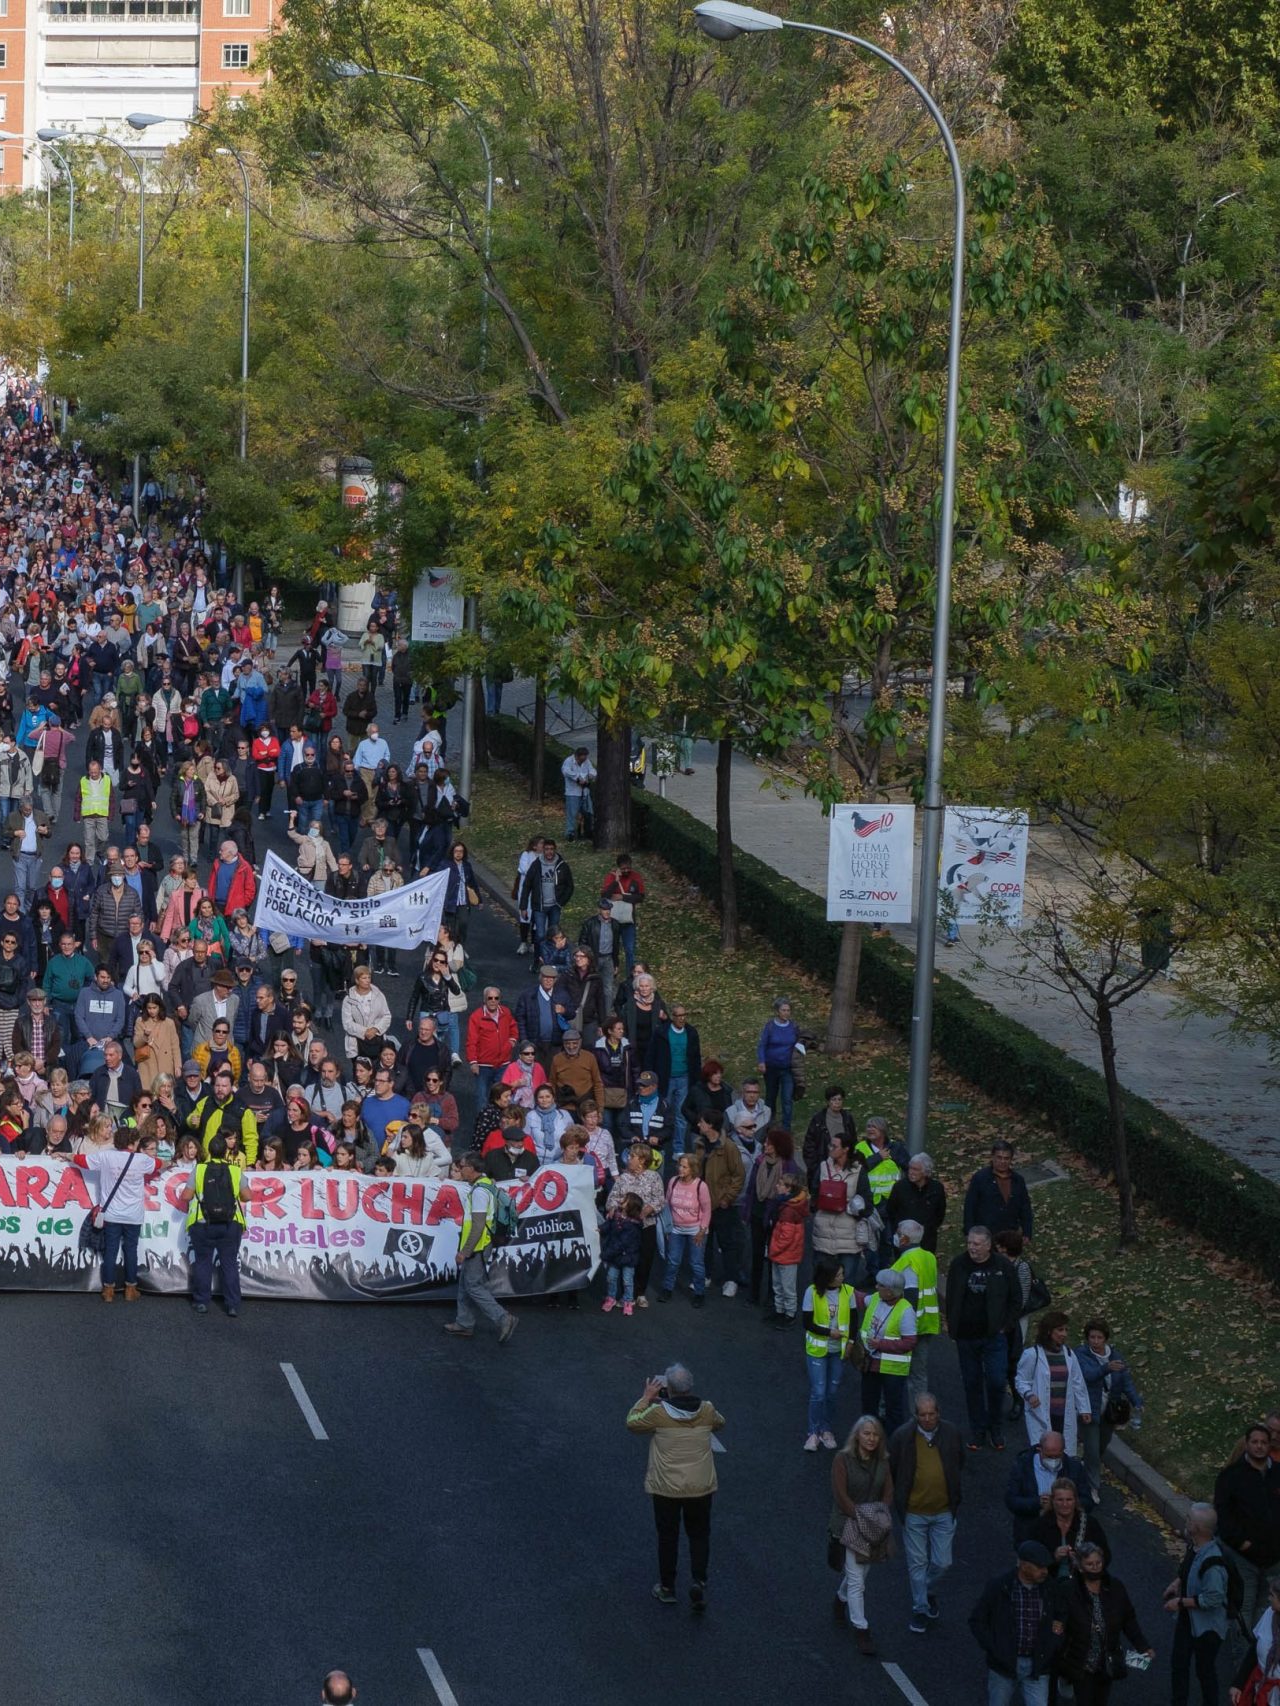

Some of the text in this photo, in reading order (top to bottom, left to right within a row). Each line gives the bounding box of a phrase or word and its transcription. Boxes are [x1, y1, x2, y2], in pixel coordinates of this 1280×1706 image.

[851, 843, 890, 853] IFEMA
[851, 860, 890, 870] HORSE
[852, 868, 889, 879] WEEK
[271, 868, 324, 902] RESPETA
[991, 883, 1021, 893] COPA
[264, 896, 335, 927] POBLACIÓN
[267, 885, 371, 919] RESPETA A SU
[856, 910, 889, 918] MADRID
[300, 1170, 569, 1226] LUCHADO
[36, 1216, 74, 1236] de
[526, 1221, 575, 1240] pública
